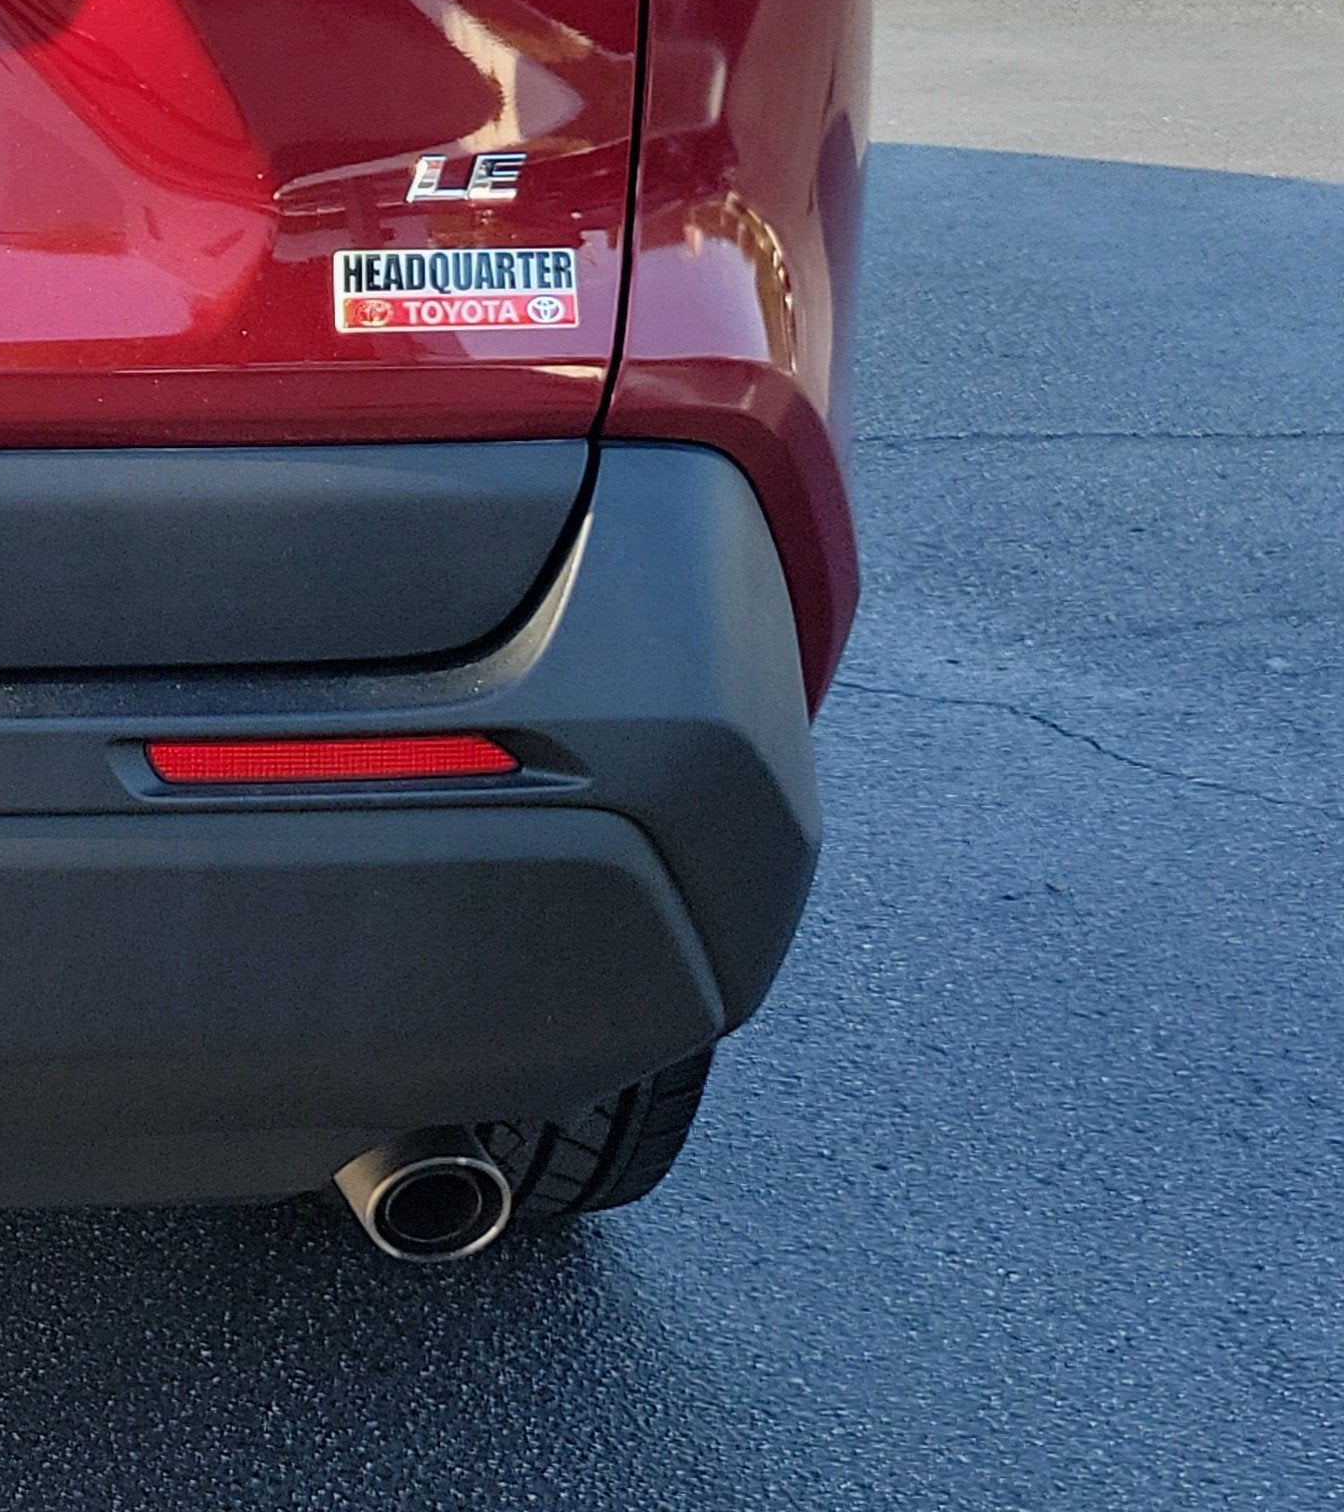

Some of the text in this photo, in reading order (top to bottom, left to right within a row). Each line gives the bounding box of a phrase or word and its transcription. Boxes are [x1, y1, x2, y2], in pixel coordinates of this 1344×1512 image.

[406, 153, 528, 204] LE
[343, 250, 573, 295] HEADQUARTER
[402, 299, 520, 325] TOYOTA
